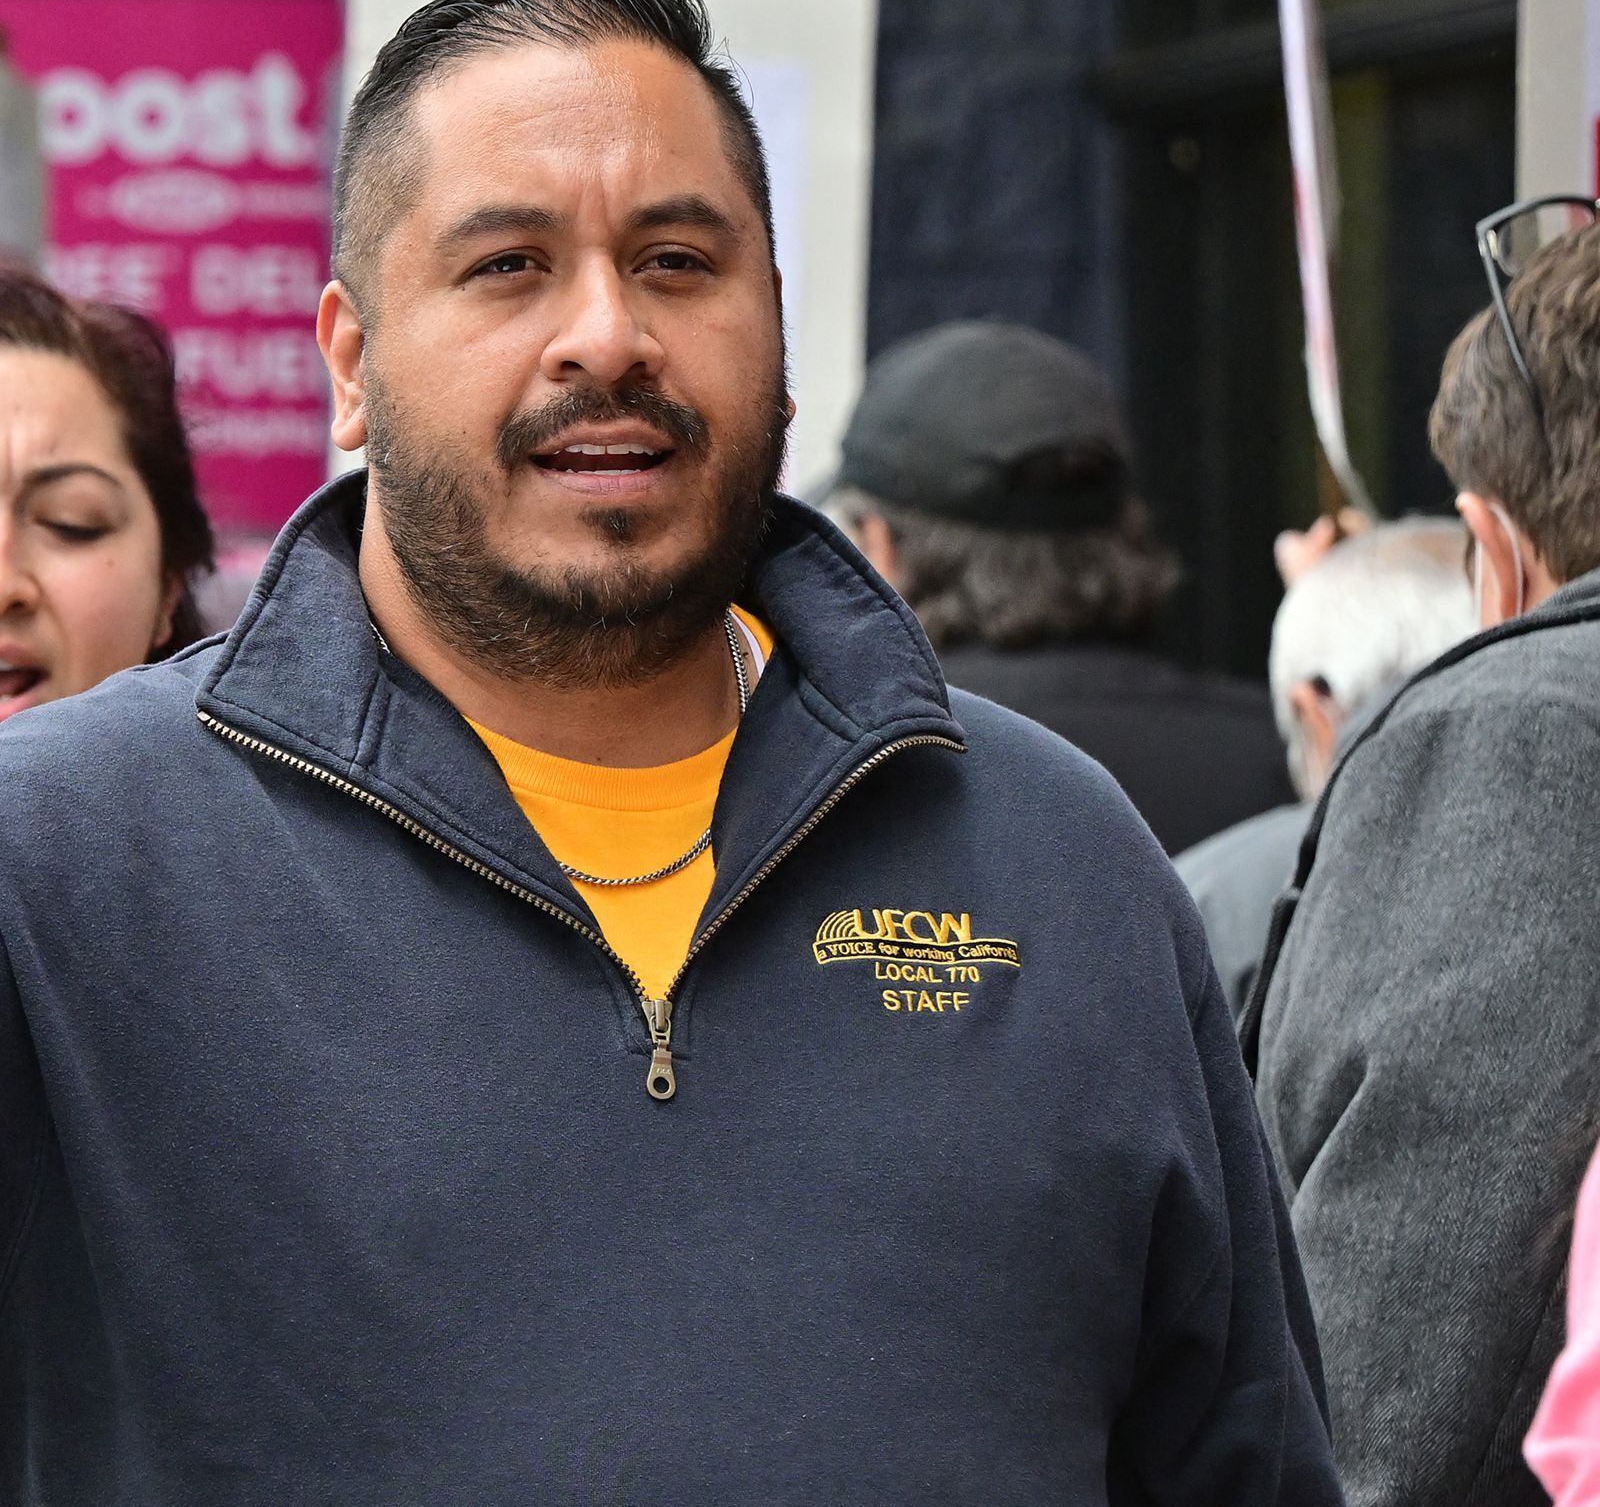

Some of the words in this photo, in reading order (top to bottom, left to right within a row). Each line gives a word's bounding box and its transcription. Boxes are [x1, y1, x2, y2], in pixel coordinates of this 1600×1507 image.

[853, 908, 972, 944] UFCW
[817, 949, 827, 960] a
[826, 942, 876, 956] VOICE
[878, 944, 900, 957] for
[903, 947, 955, 963] working
[957, 945, 1018, 961] California
[875, 962, 943, 983] LOCAL
[945, 966, 981, 983] 770
[882, 989, 970, 1013] STAFF
